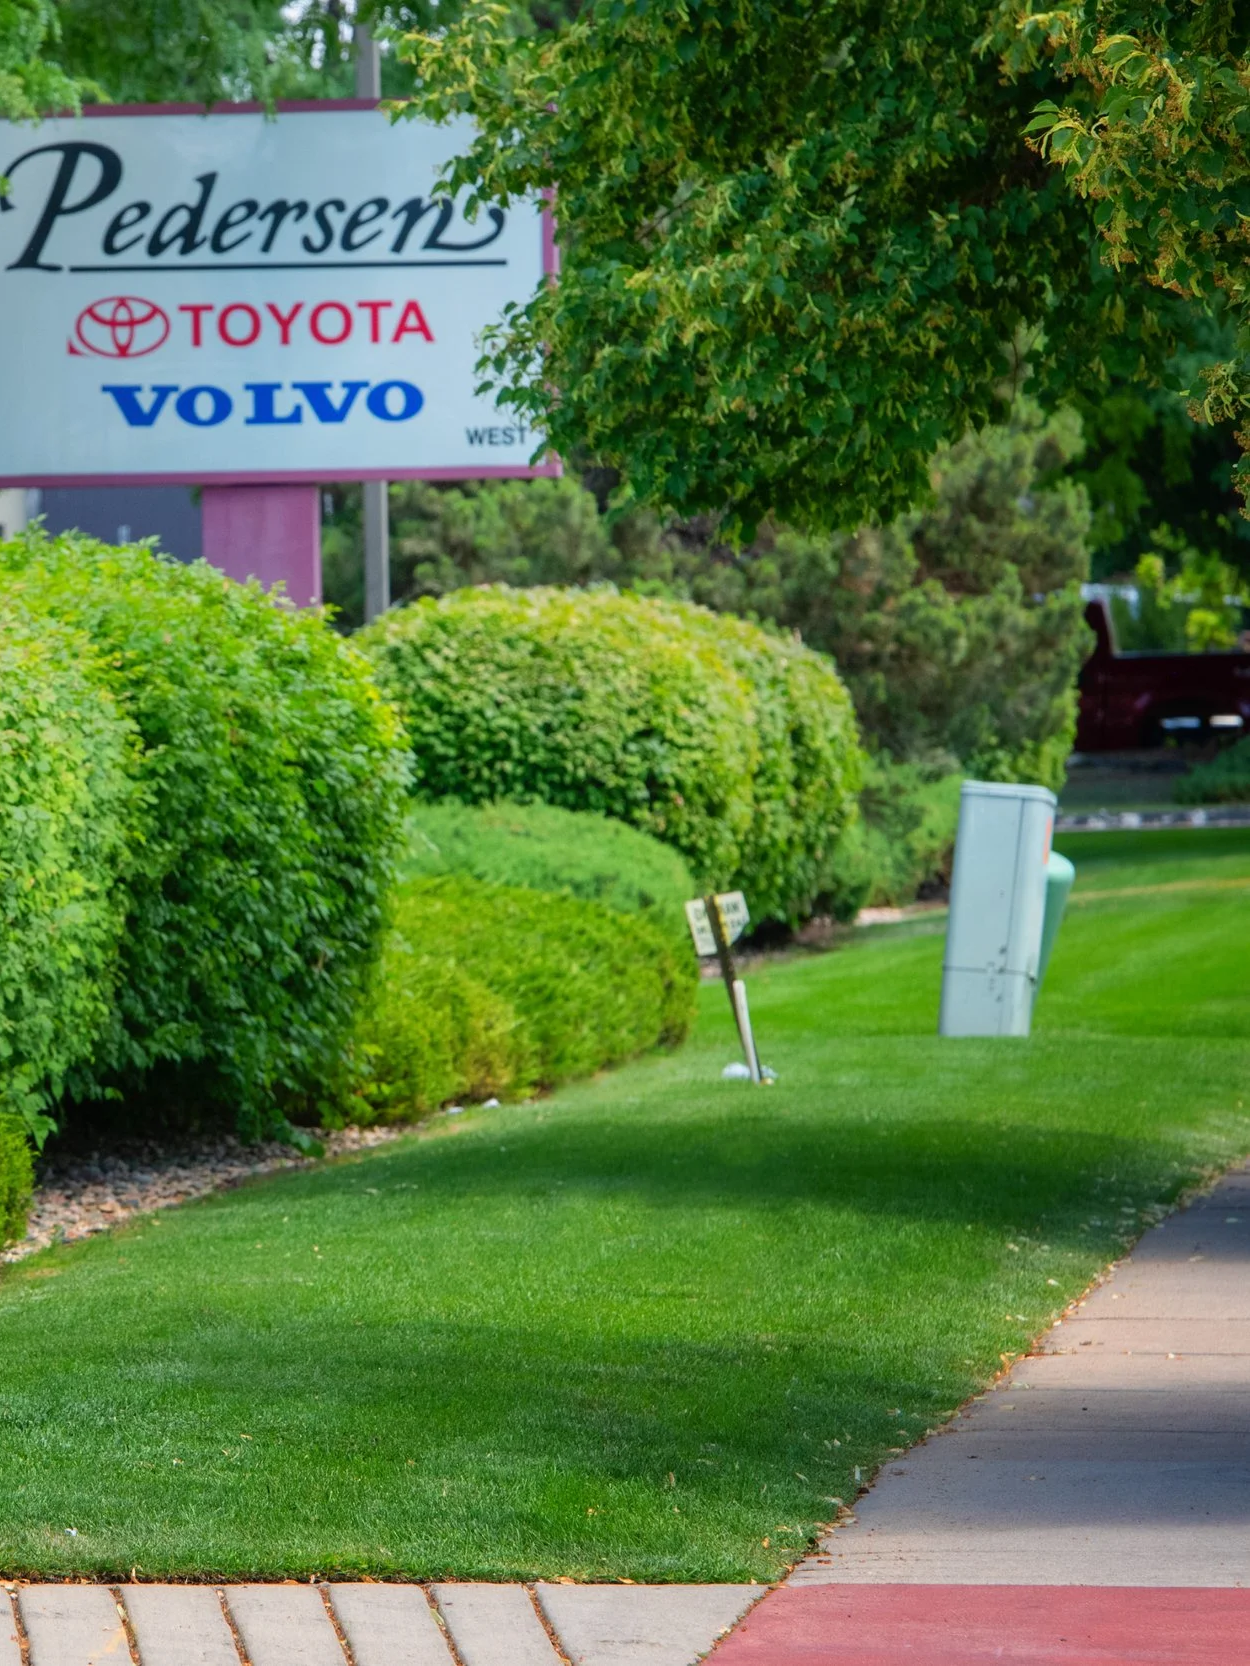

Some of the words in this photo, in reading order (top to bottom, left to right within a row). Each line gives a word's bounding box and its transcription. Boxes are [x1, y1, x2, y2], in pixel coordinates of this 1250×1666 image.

[0, 141, 506, 272] Pedersen
[179, 300, 435, 348] TOYOTA
[101, 380, 425, 427] VOLVO
[465, 426, 527, 446] WEST
